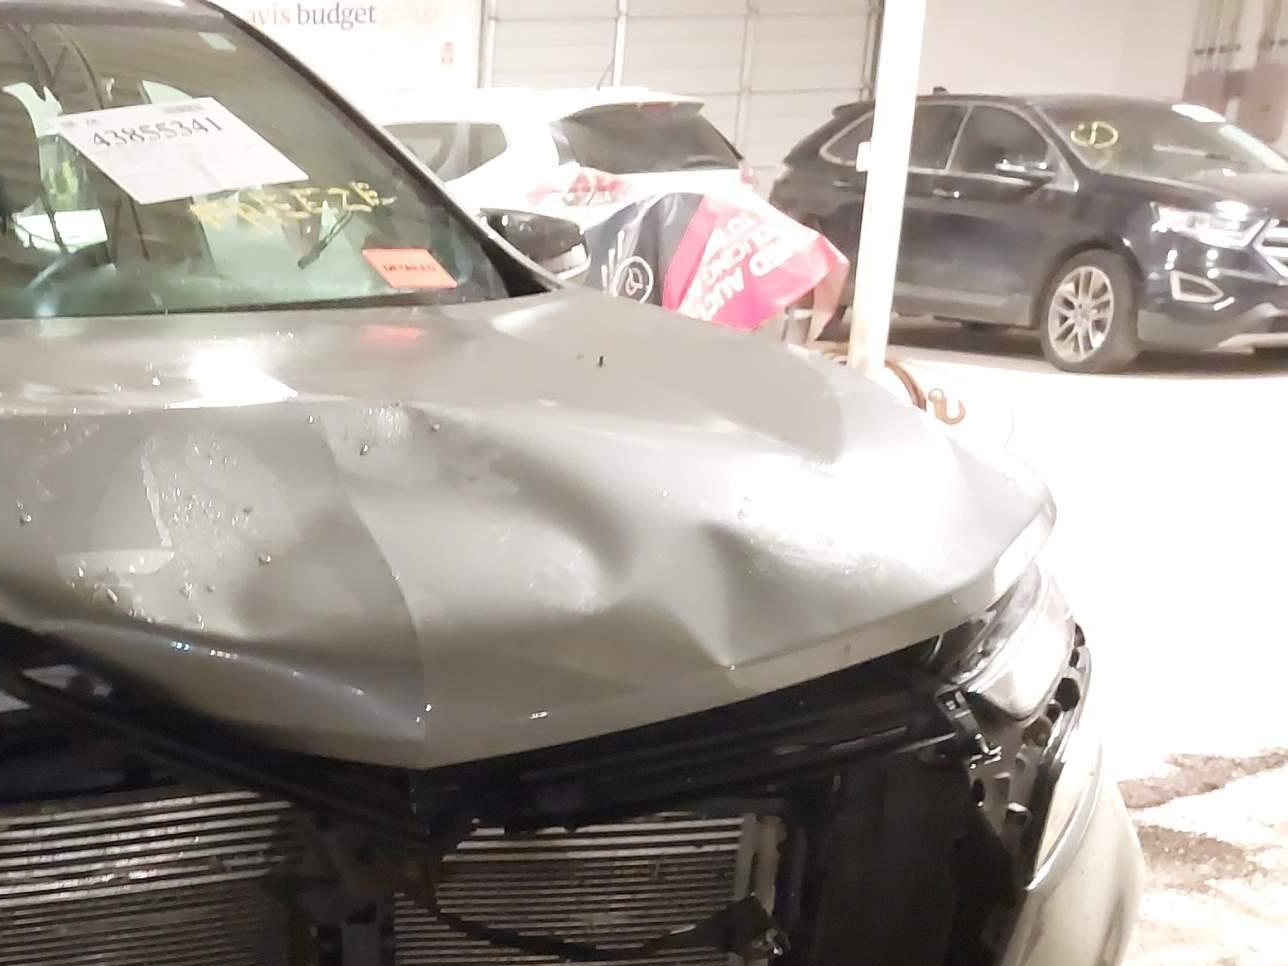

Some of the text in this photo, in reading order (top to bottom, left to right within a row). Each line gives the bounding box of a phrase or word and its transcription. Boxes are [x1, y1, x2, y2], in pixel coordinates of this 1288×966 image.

[247, 1, 291, 25] avis
[296, 3, 378, 31] budget
[92, 115, 224, 149] 43855341
